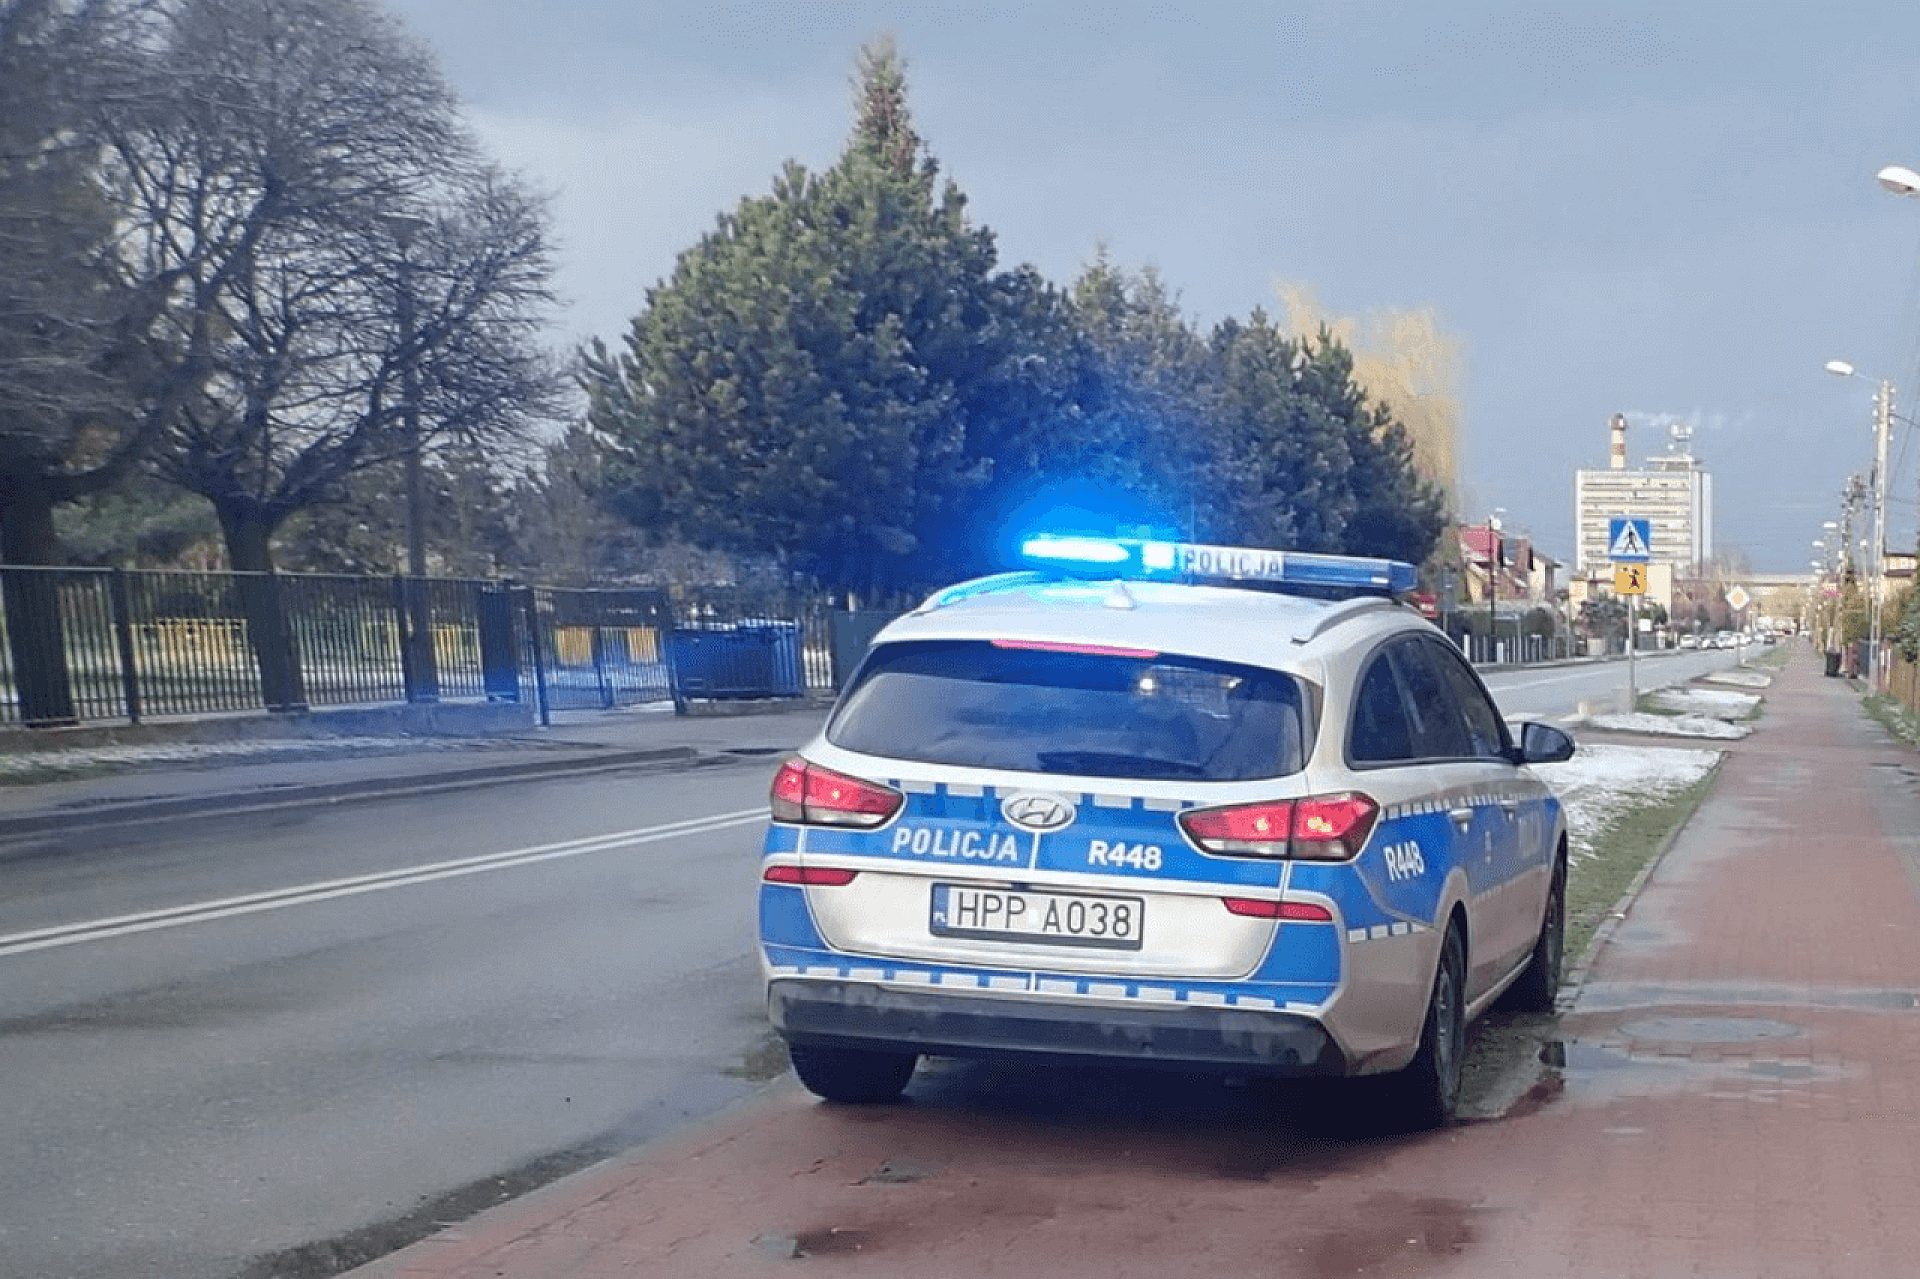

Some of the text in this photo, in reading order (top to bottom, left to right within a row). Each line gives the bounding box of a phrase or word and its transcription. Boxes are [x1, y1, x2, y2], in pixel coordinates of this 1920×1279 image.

[892, 828, 1018, 861] POLICJA
[1088, 840, 1162, 871] R448
[1383, 840, 1425, 881] R448
[957, 891, 1131, 937] HPP A038
